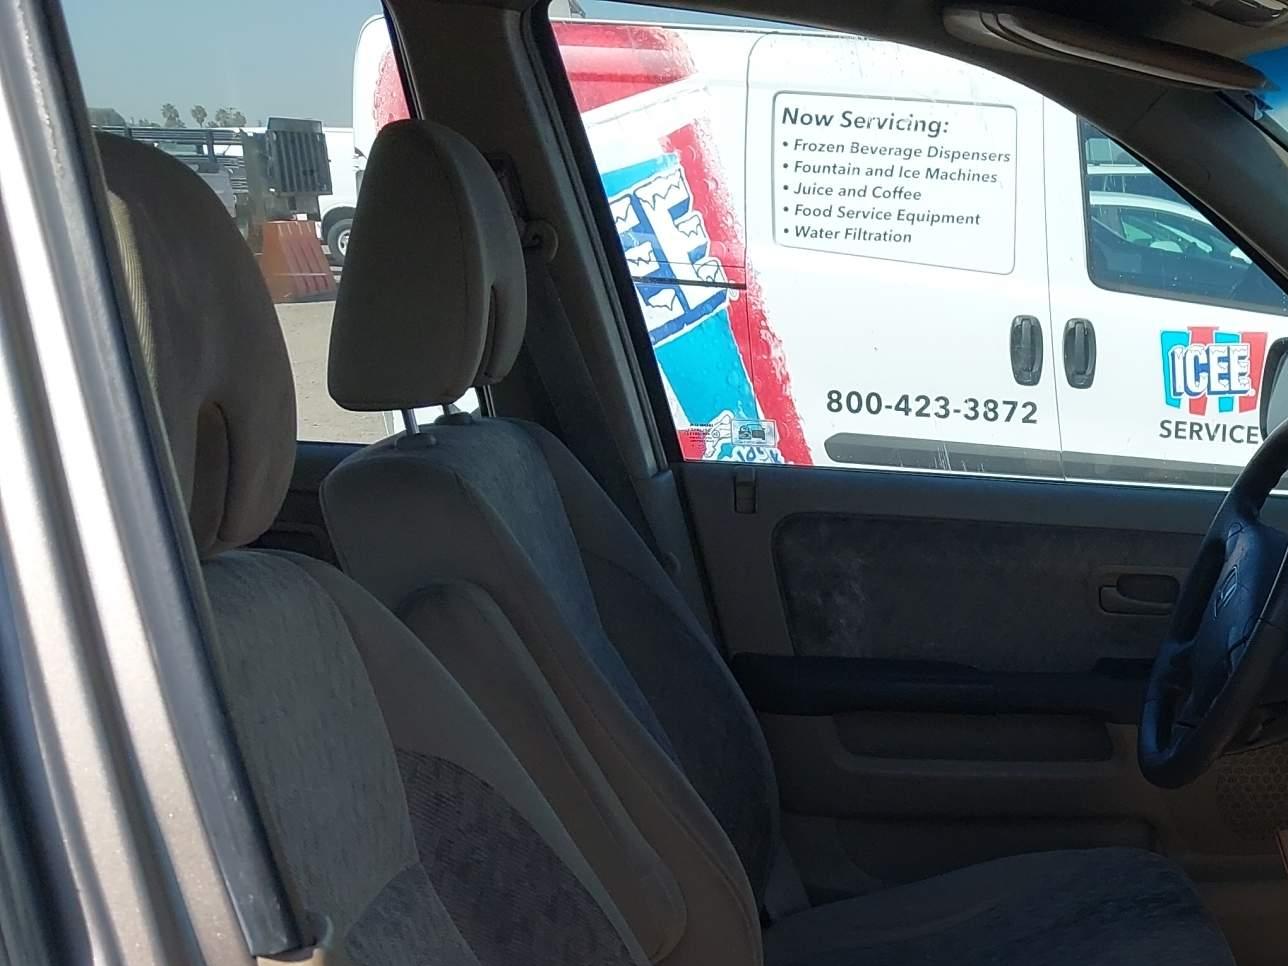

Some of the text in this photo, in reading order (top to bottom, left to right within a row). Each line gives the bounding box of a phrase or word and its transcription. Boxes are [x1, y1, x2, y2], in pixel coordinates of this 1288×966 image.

[782, 107, 949, 138] Now Servicing:
[794, 138, 1011, 163] Frozen Beverage Dispensers
[794, 160, 998, 183] Fountain and Ice Machines
[793, 182, 922, 201] Juice and Coffee
[794, 204, 981, 225] Food Service Equipment
[794, 225, 912, 243] Water Filtration
[1170, 344, 1251, 397] ICEE
[826, 389, 1038, 424] 800-423-3872
[1159, 419, 1259, 445] SERVICE
